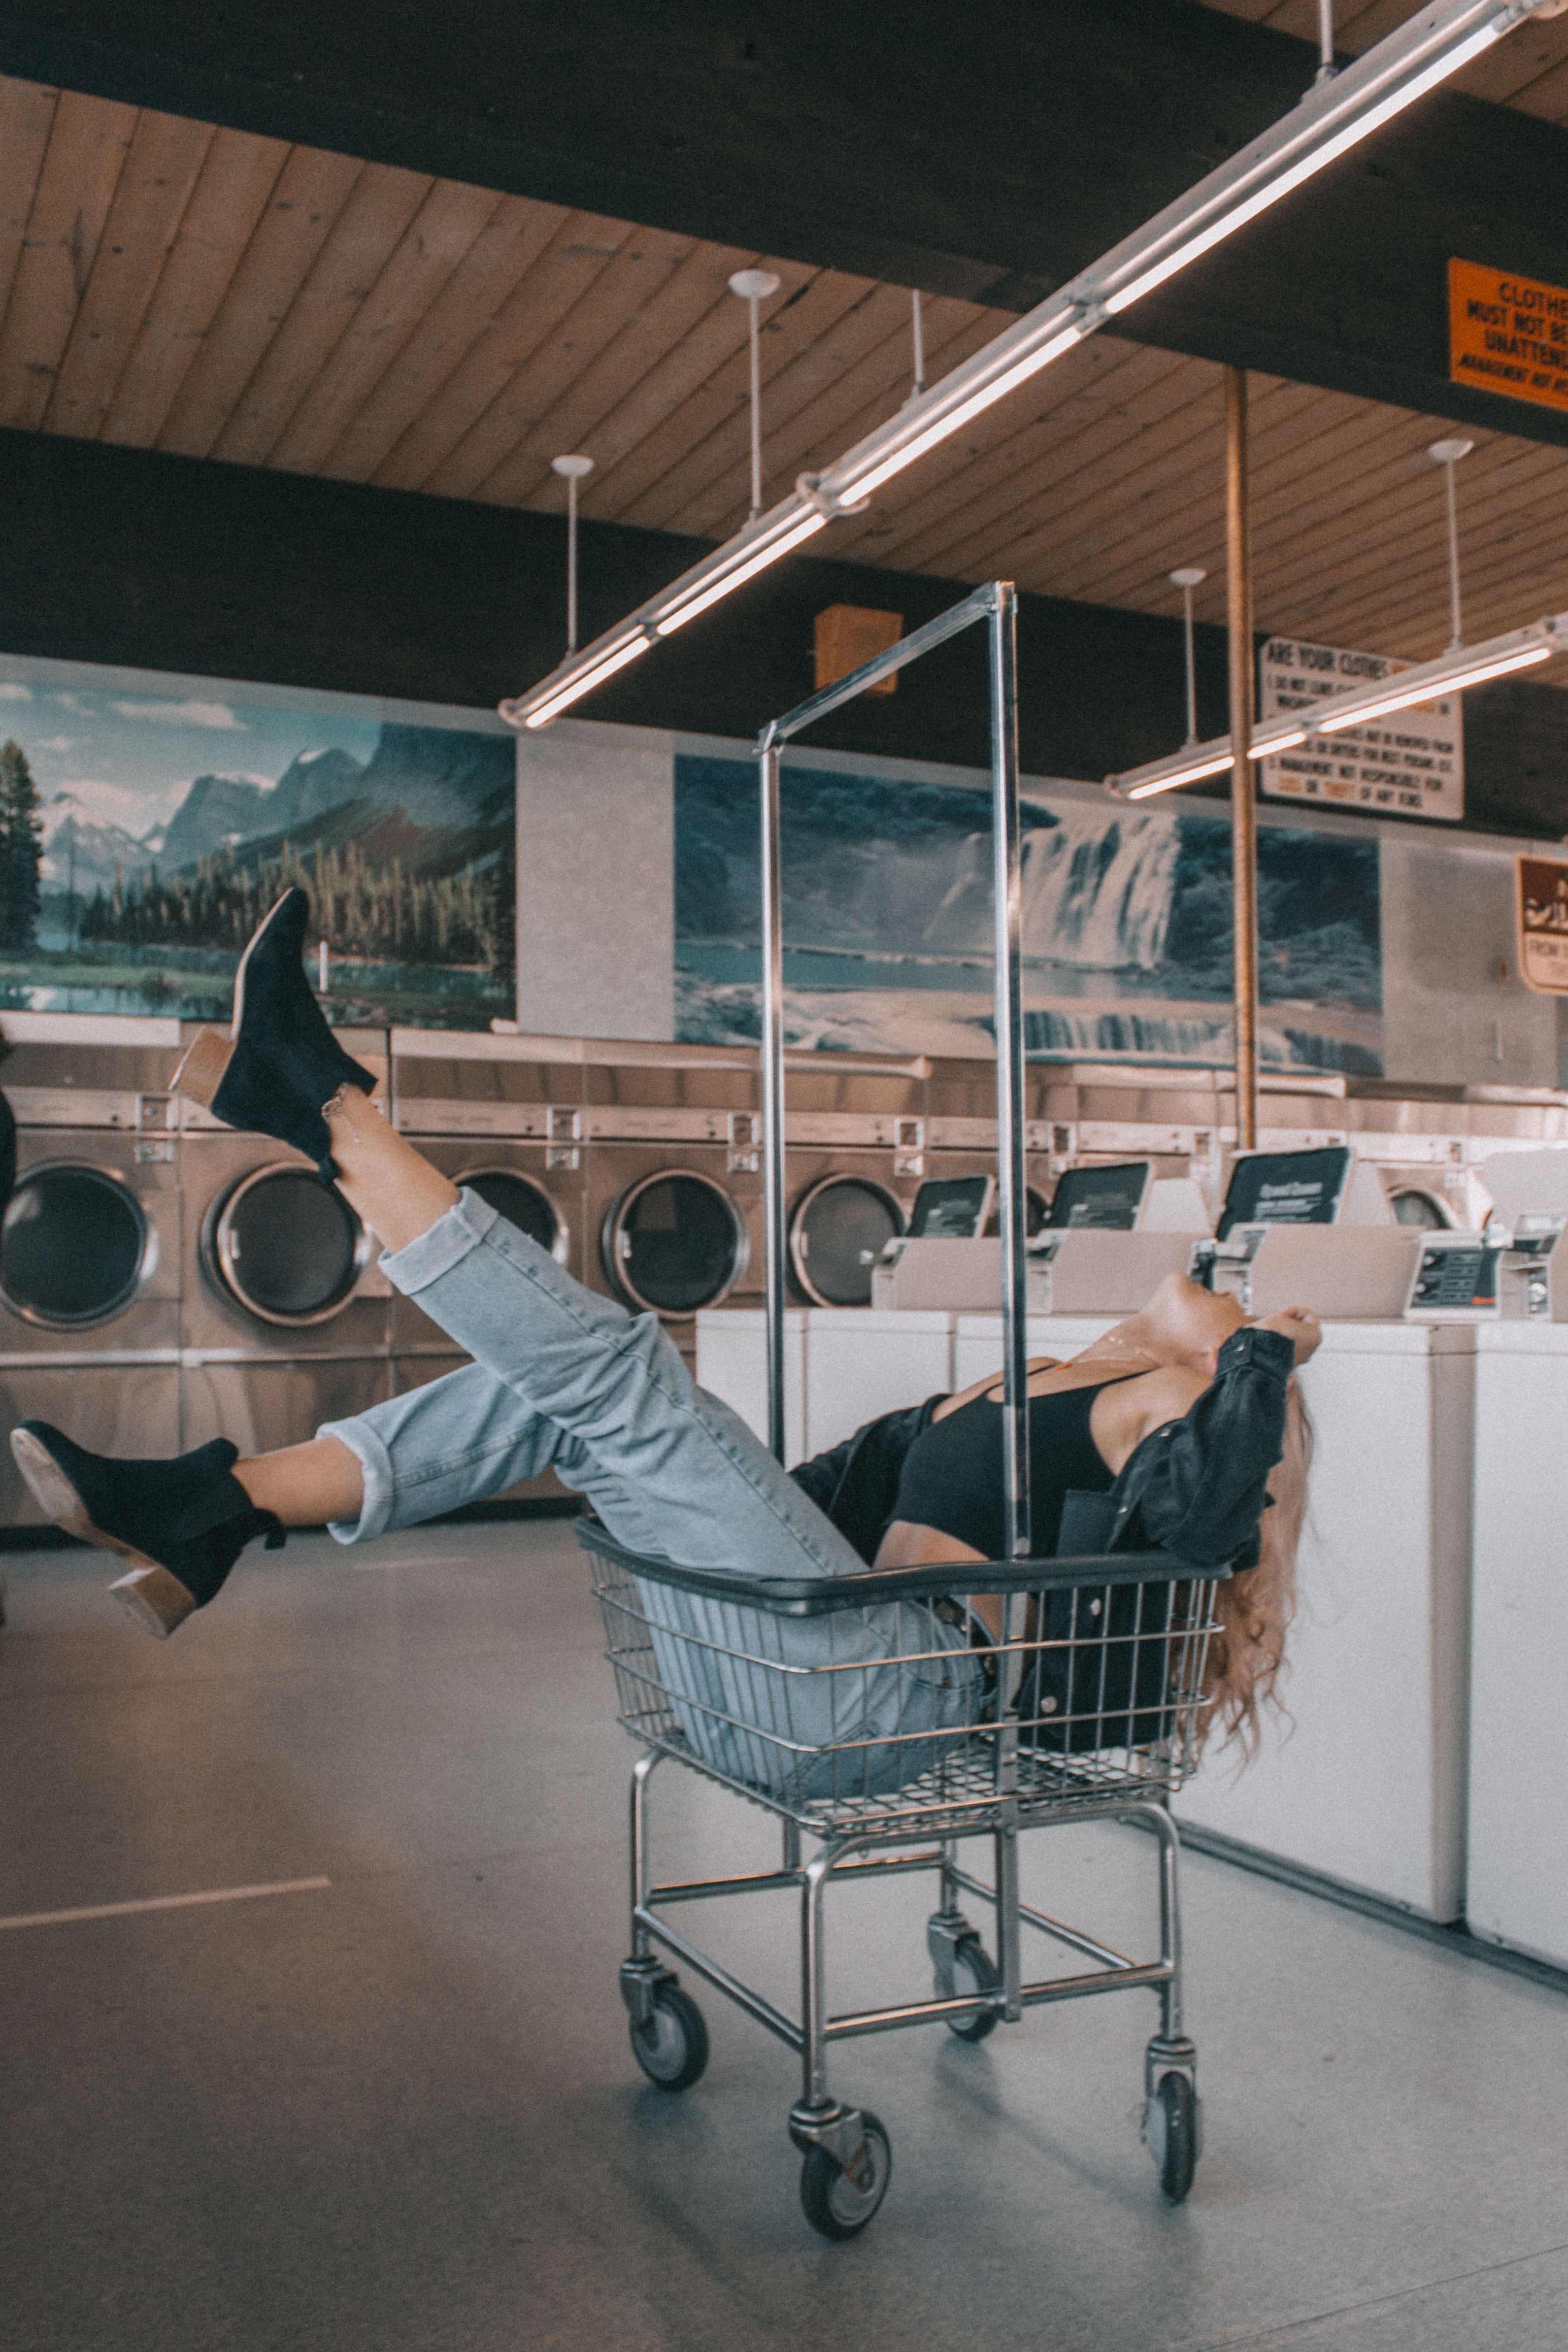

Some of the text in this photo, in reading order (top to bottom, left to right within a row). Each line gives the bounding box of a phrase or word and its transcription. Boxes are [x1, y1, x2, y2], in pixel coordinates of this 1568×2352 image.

[1467, 298, 1508, 328] MUST
[1514, 311, 1545, 338] NOT
[1499, 281, 1568, 319] CLOTHE
[1268, 643, 1293, 666] ARE
[1299, 646, 1334, 671] YOUR
